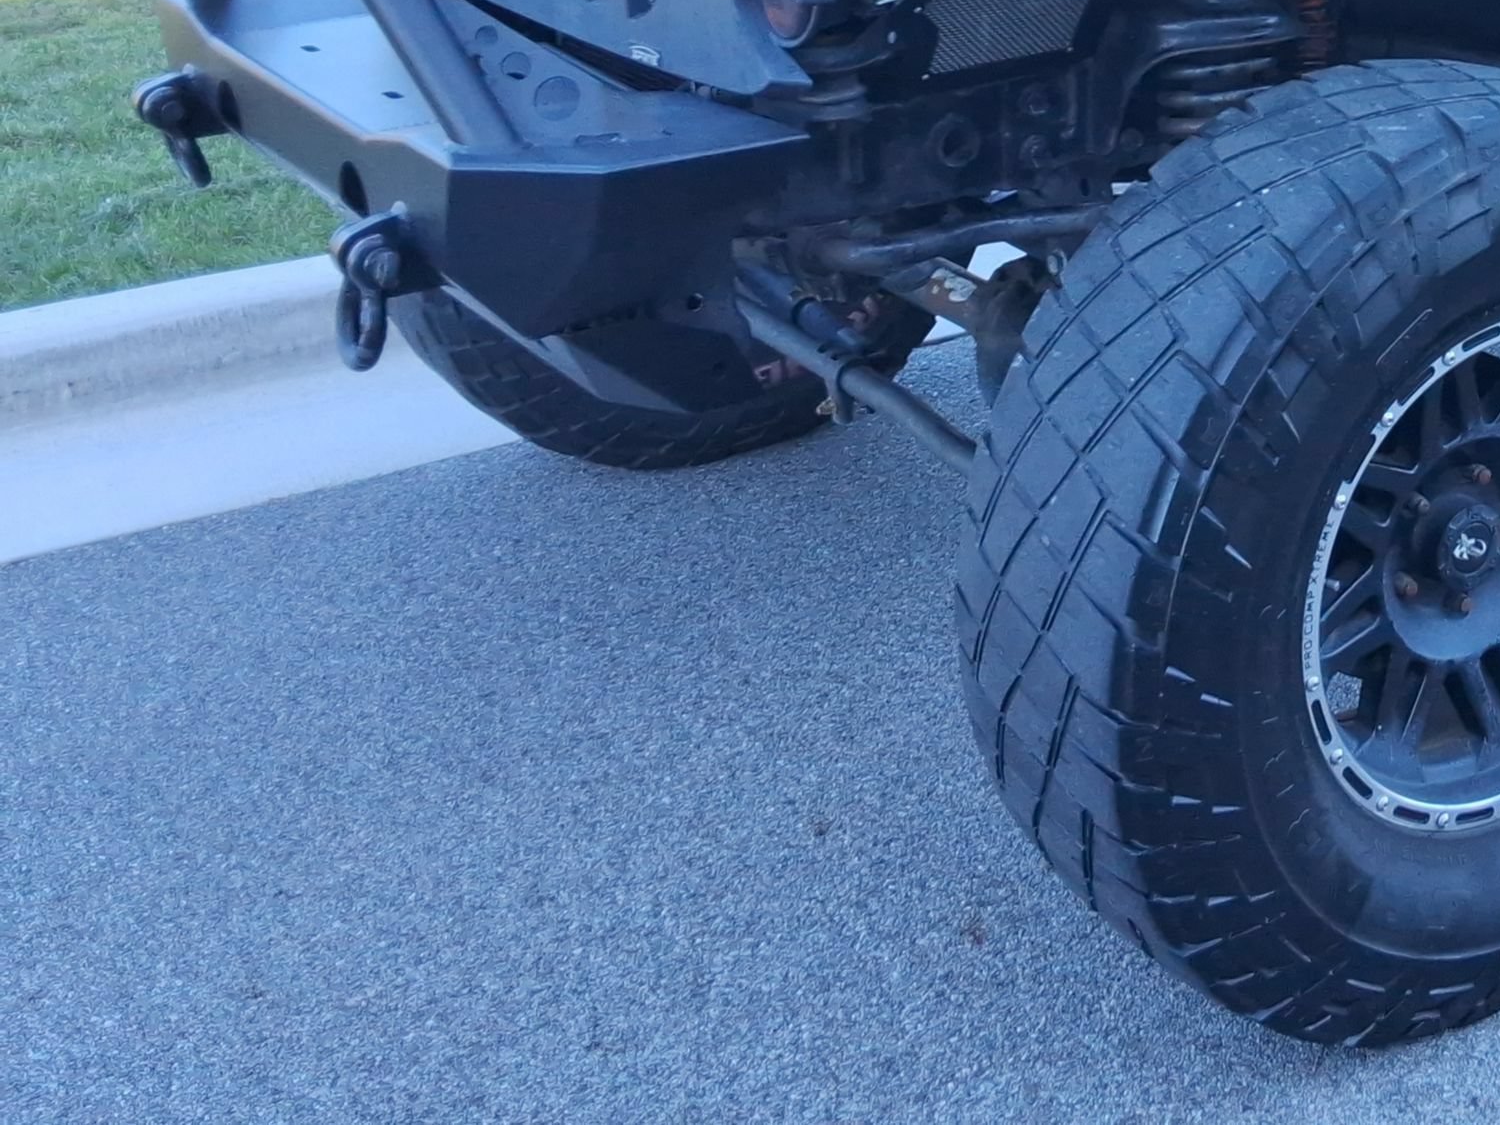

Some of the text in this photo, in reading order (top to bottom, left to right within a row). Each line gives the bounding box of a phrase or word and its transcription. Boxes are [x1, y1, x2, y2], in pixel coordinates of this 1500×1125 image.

[1303, 520, 1336, 670] PRO COMP XTREME
